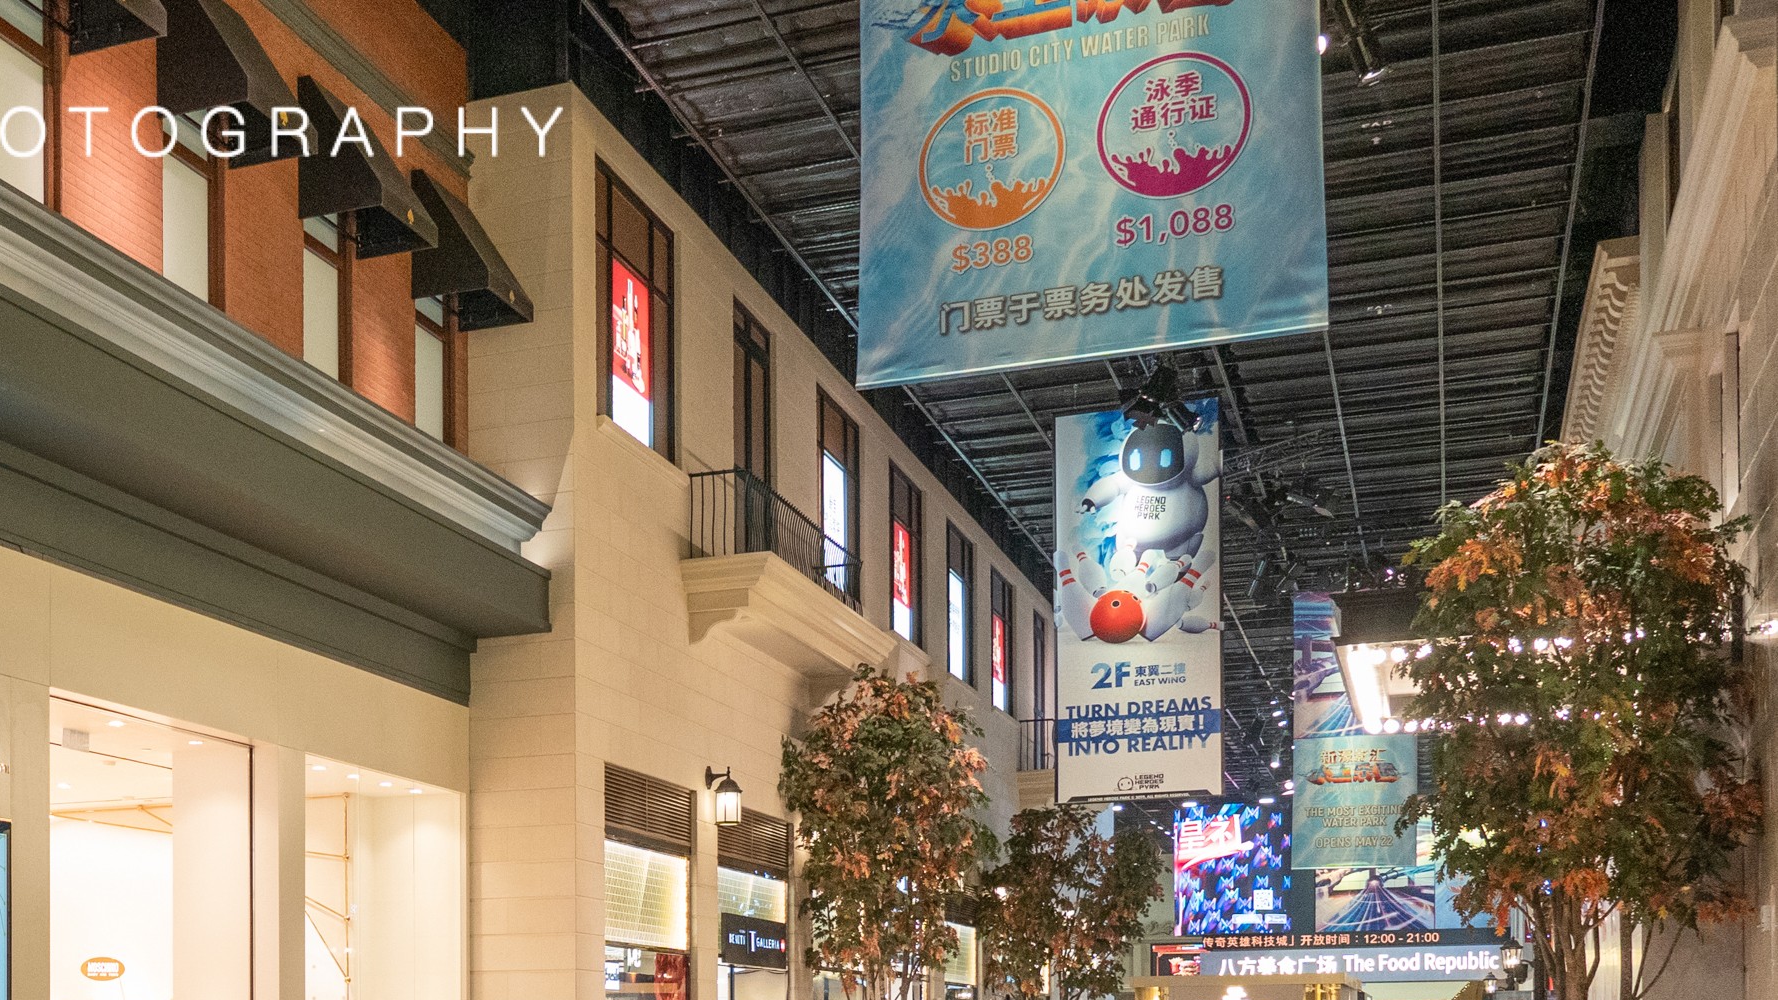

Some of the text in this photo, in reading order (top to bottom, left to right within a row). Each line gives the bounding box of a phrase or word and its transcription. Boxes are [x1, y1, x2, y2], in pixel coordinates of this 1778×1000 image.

[950, 48, 1022, 82] STUDIO
[1029, 39, 1075, 68] CITY
[1080, 25, 1150, 58] WATER
[1156, 13, 1211, 45] PARK
[1146, 71, 1202, 102] 泳季
[963, 107, 1017, 139] 标准
[1131, 95, 1216, 132] 通行证
[964, 133, 1018, 165] 门票
[1115, 204, 1234, 248] $1,088
[951, 235, 1033, 274] $388
[939, 266, 1224, 335] 门票于票务处发售
[1091, 661, 1131, 689] 2F
[1134, 678, 1155, 686] EAST
[1135, 663, 1186, 677] 東翼二樓
[1066, 696, 1212, 720] TURN DREAMS
[1068, 732, 1212, 756] INTO REALITY
[1305, 807, 1324, 817] THE
[1327, 806, 1356, 817] MOST
[1323, 816, 1387, 828] WATER PARK
[1315, 836, 1393, 848] OPENS MAY 22
[749, 930, 780, 952] T GALLERIA
[1364, 933, 1396, 944] 12:00
[1406, 932, 1440, 943] 21:00
[1219, 951, 1500, 976] 八方美食广场 The Food Republic
